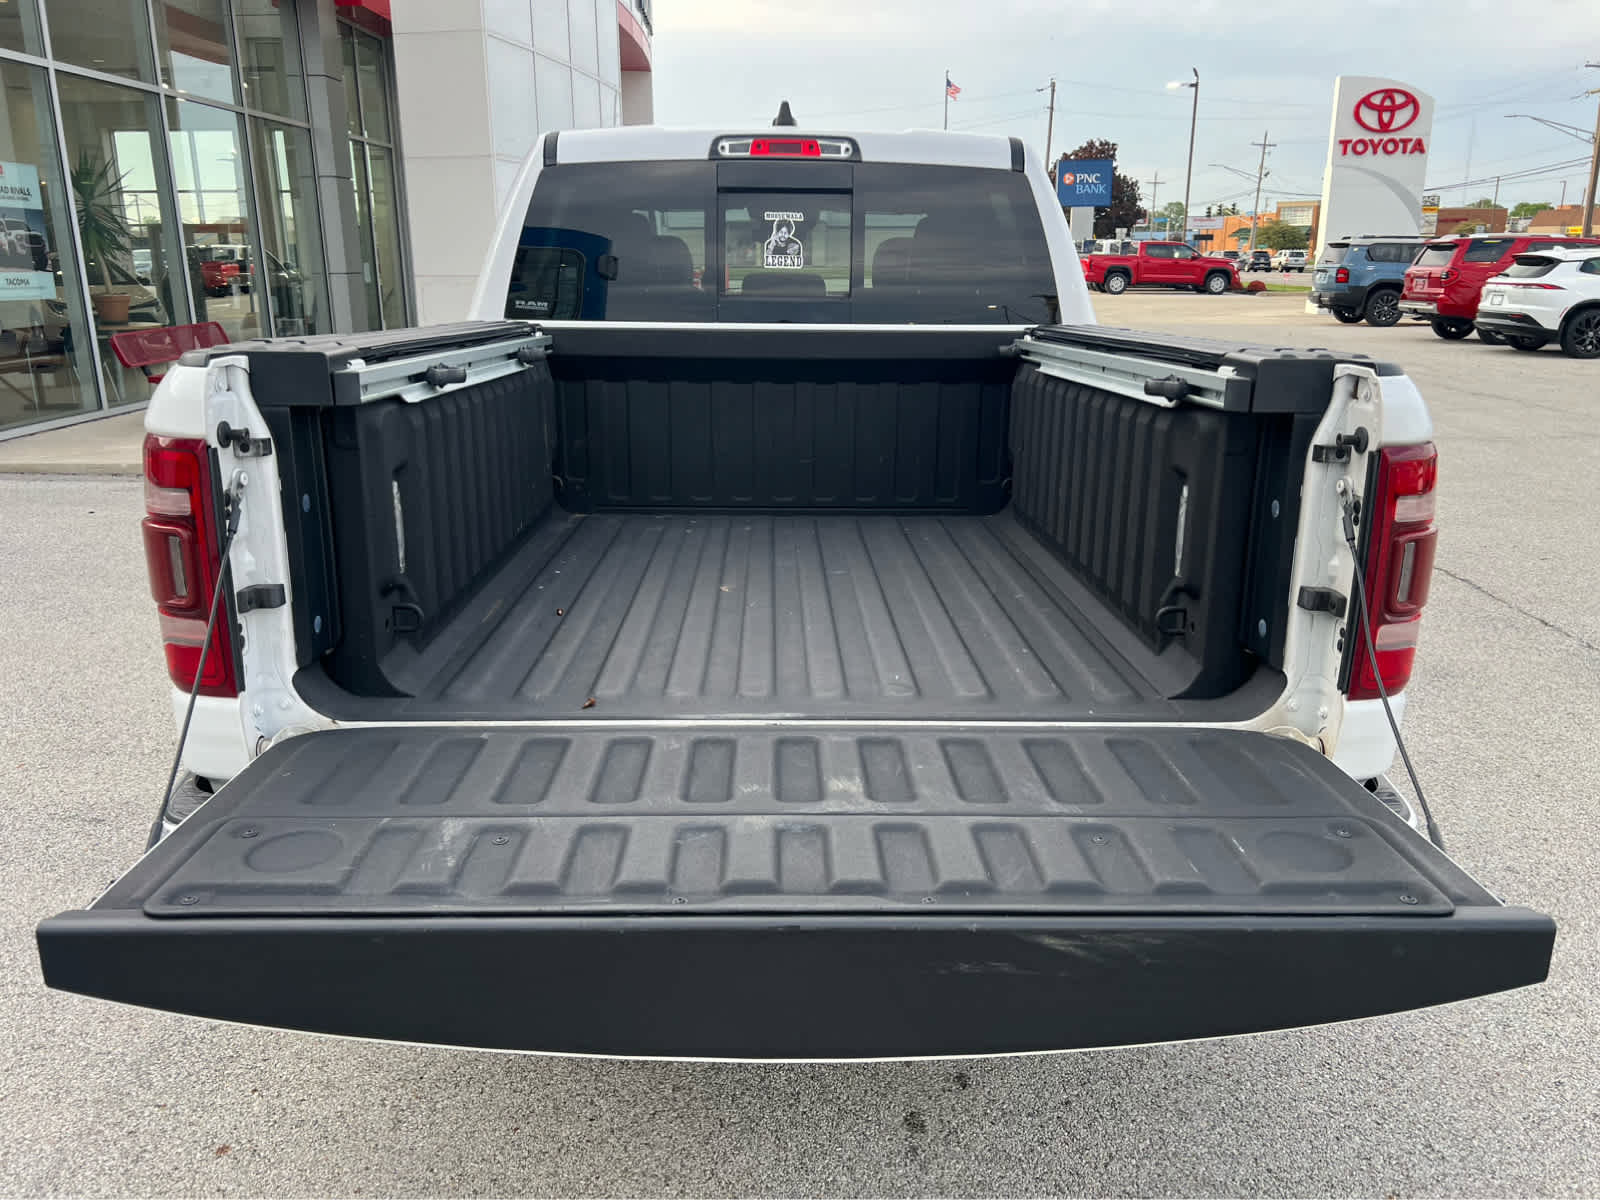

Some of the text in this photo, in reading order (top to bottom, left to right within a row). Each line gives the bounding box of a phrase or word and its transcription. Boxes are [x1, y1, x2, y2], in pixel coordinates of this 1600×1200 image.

[1338, 137, 1426, 156] TOYOTA
[1075, 172, 1101, 184] PNC
[1075, 184, 1107, 194] BANK
[765, 255, 803, 267] LEGEND
[5, 278, 31, 286] TACOMA
[515, 300, 549, 308] RAM
